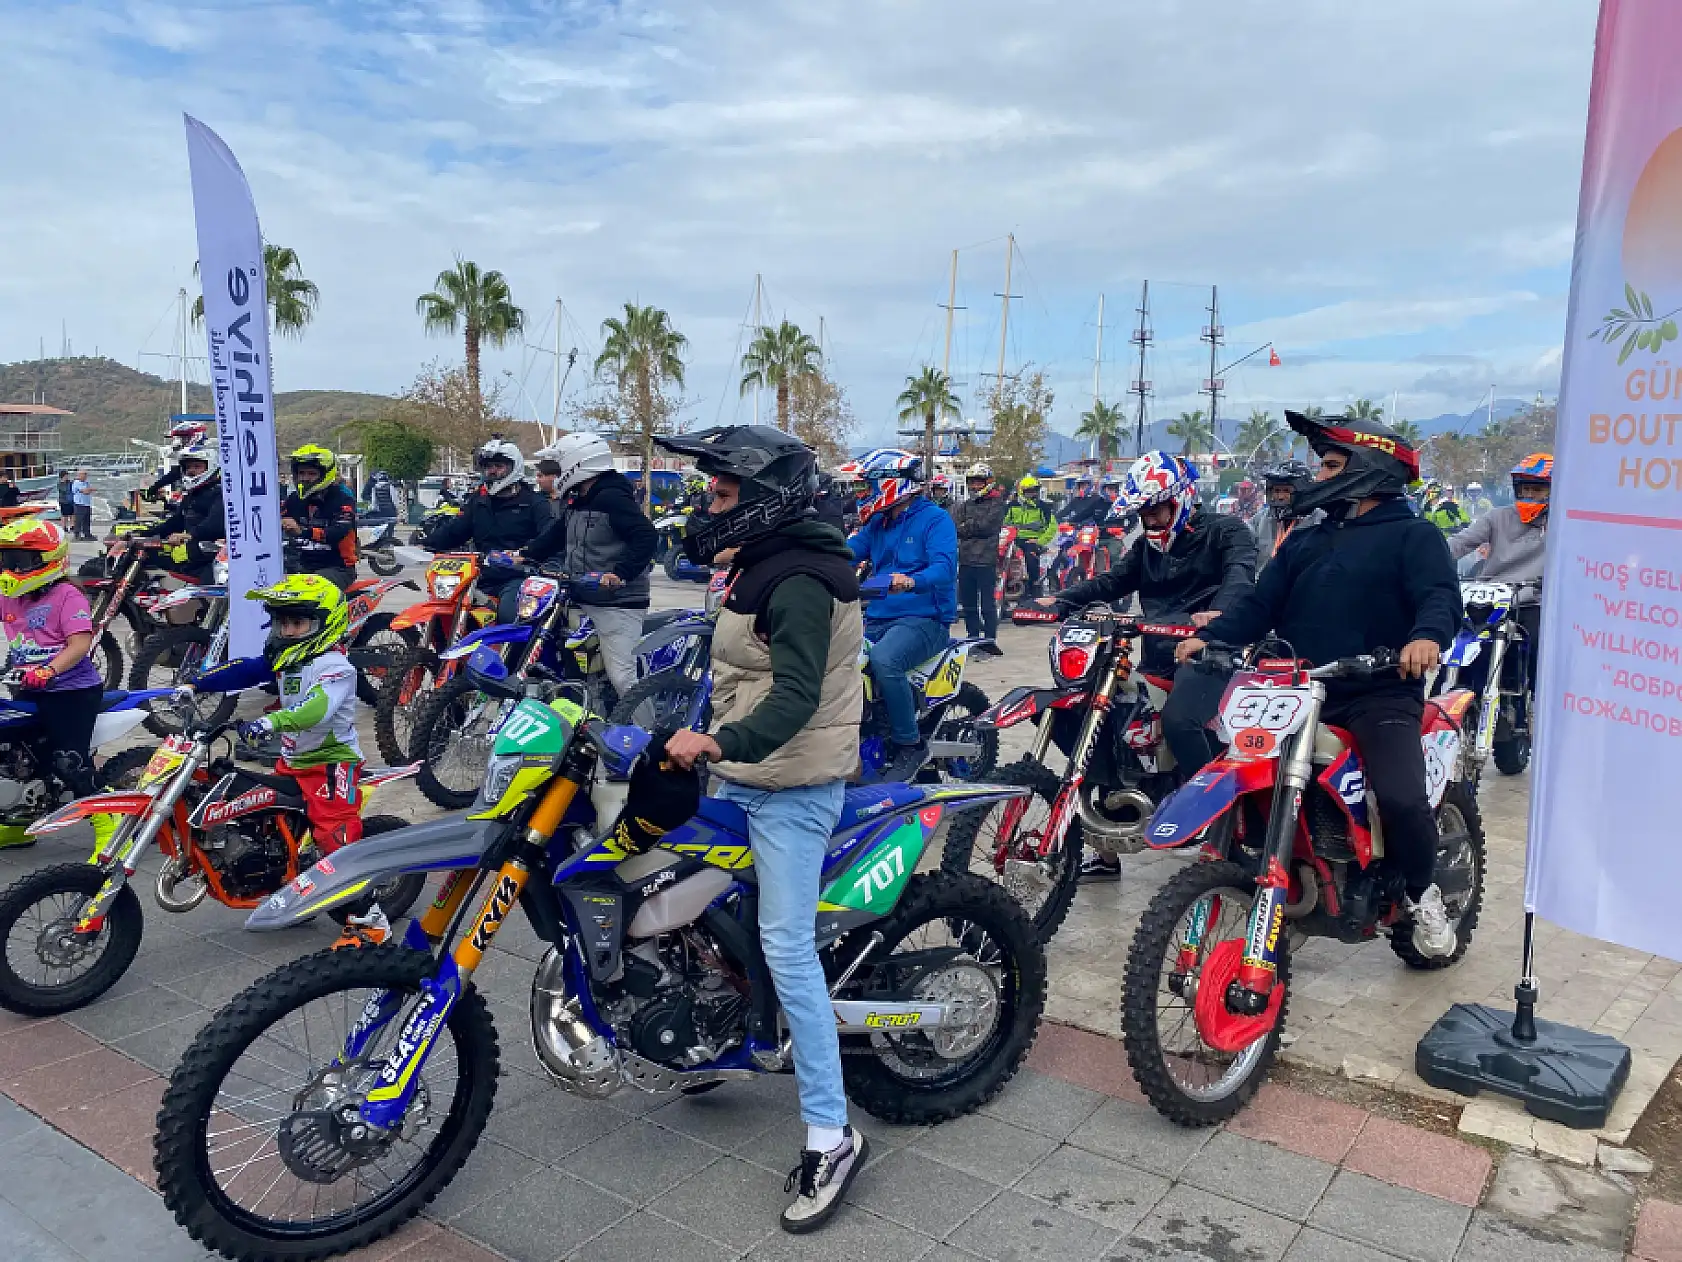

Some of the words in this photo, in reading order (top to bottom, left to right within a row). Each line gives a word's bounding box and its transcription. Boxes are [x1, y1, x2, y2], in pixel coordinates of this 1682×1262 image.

[1594, 593, 1682, 629] "WELCO
[1229, 694, 1302, 731] 38
[1243, 735, 1265, 750] 38
[853, 845, 905, 905] 707
